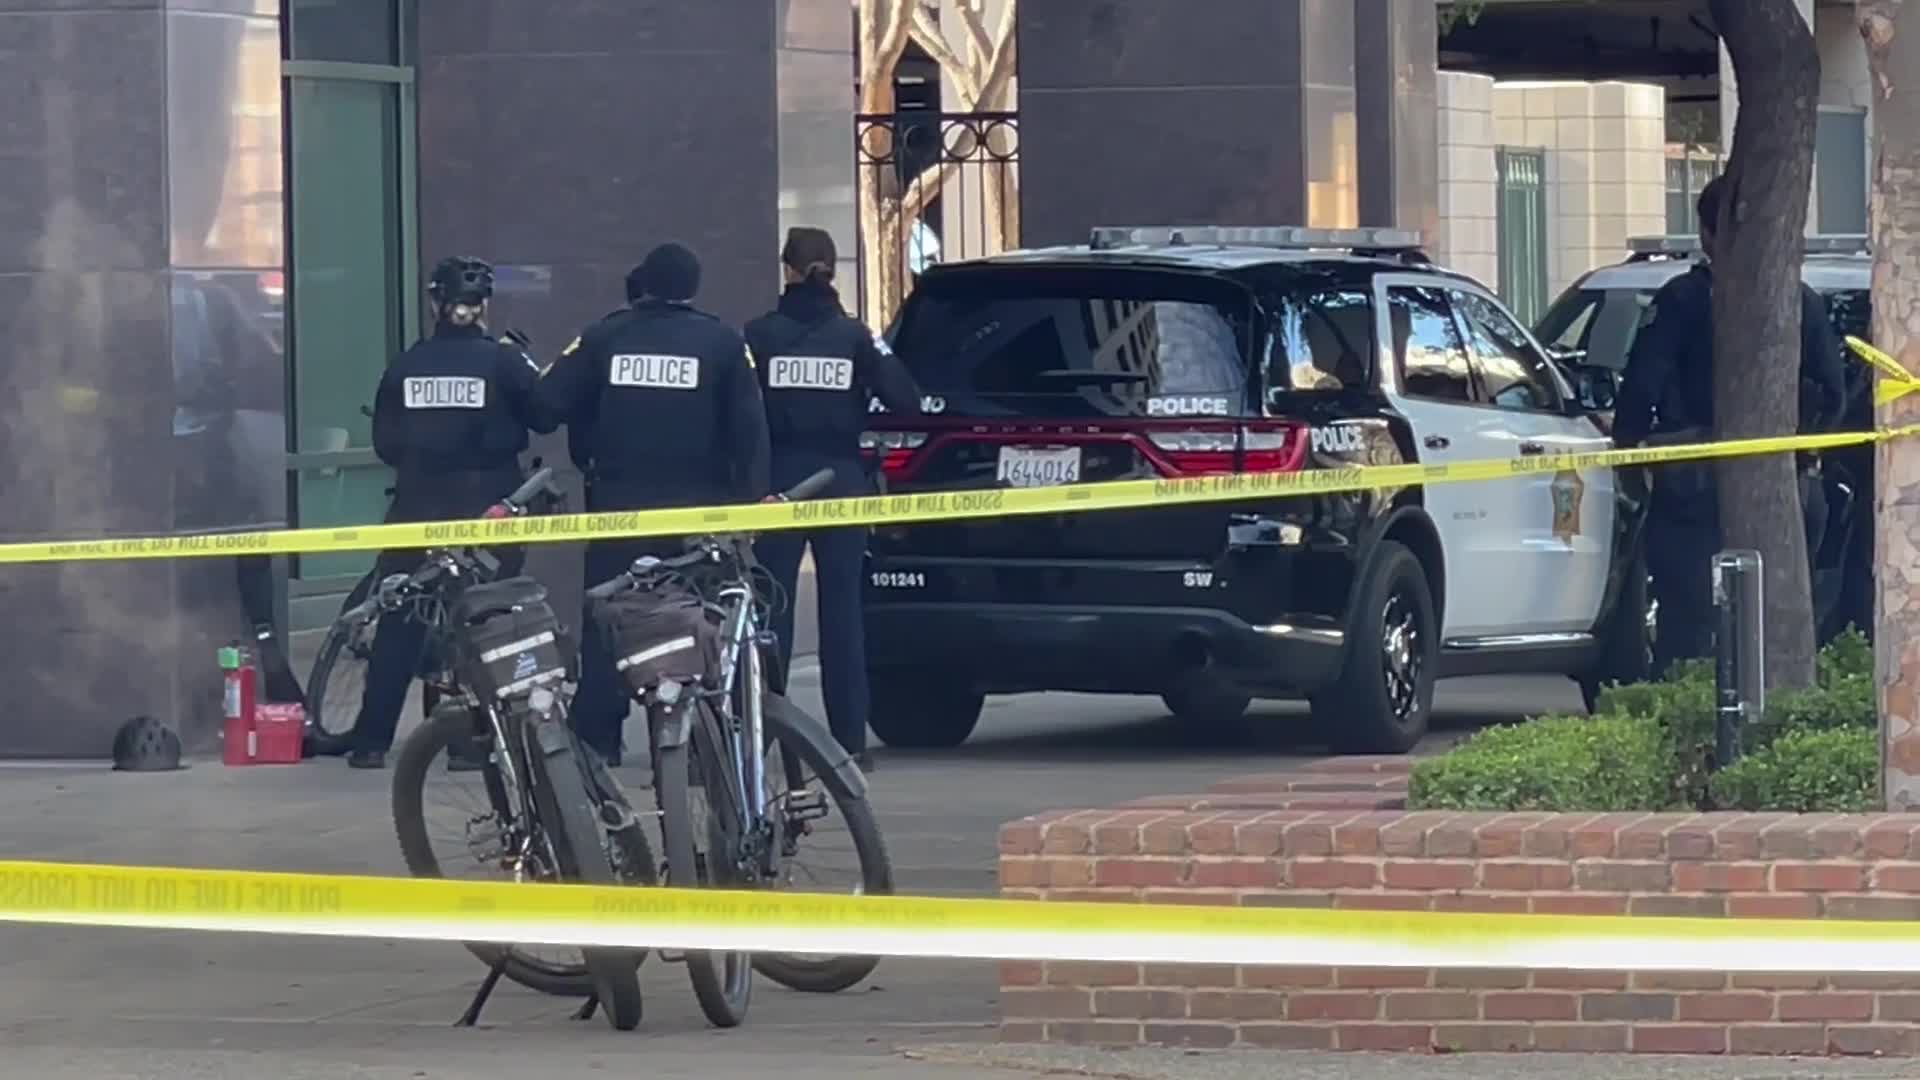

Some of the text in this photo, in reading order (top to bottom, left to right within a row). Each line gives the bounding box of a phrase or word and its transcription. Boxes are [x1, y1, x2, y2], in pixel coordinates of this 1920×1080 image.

[619, 357, 692, 384] POLICE
[775, 359, 848, 386] POLICE
[410, 380, 478, 405] POLICE
[1147, 398, 1228, 415] POLICE
[1311, 426, 1366, 452] POLICE
[1002, 458, 1074, 485] 1644016
[871, 572, 925, 587] 101241
[1184, 572, 1213, 587] SW
